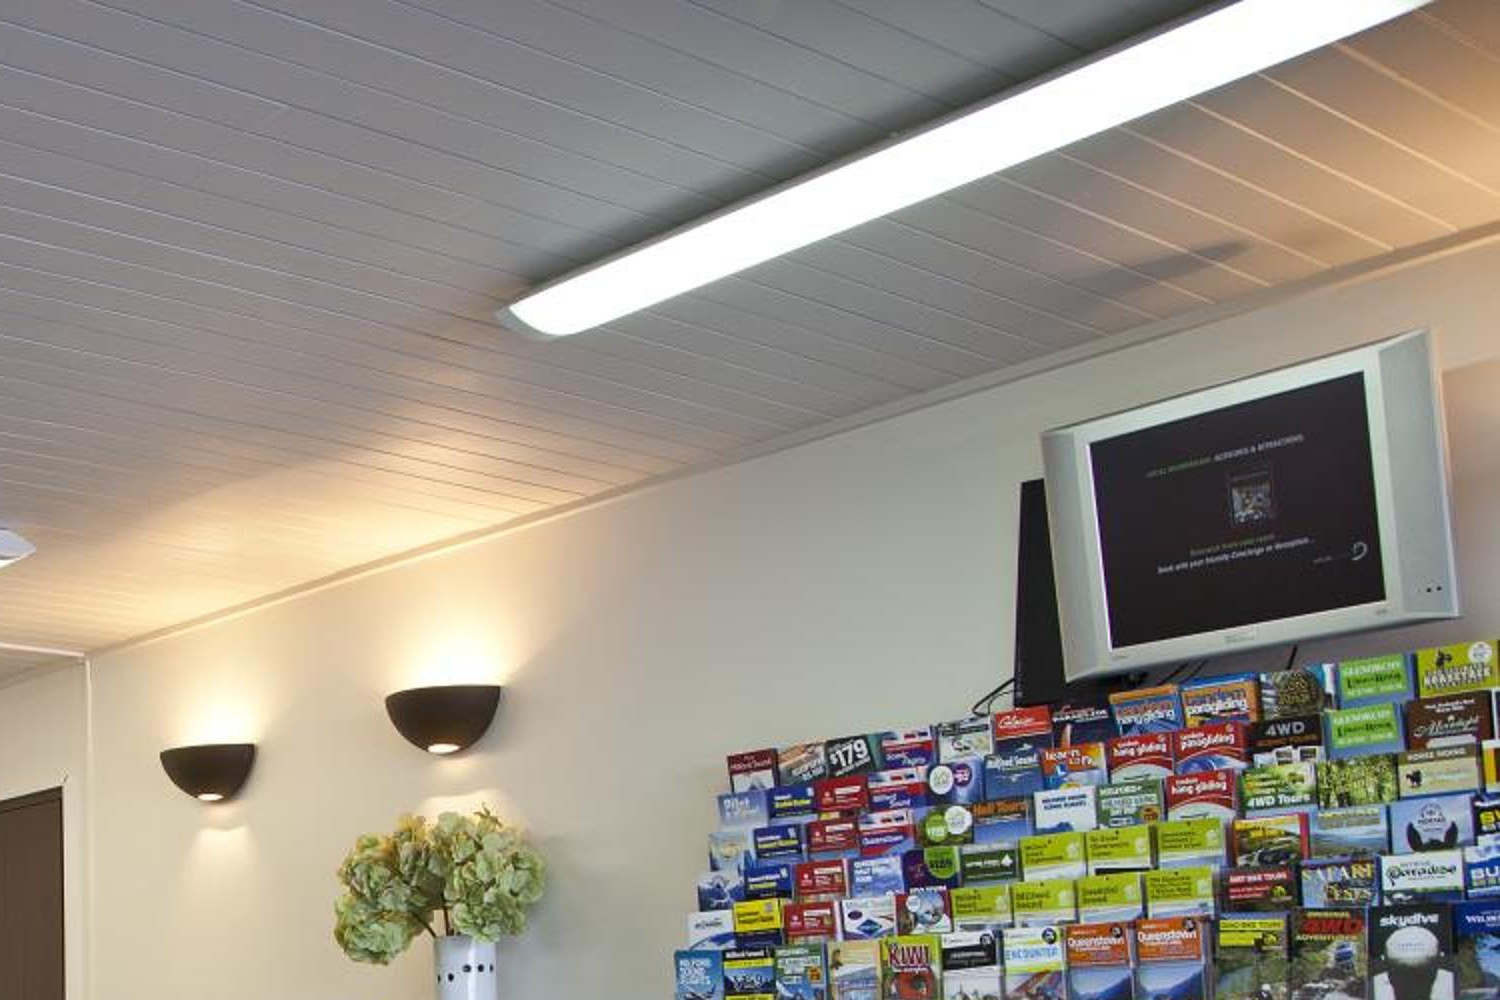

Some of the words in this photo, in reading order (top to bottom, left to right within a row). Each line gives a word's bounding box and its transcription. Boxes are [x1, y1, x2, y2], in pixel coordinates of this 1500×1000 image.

[1265, 721, 1305, 736] 4WD
[829, 738, 868, 768] $179
[1247, 797, 1275, 807] 4WD
[1277, 793, 1311, 805] Tours
[1379, 912, 1439, 928] skydive
[1068, 935, 1124, 947] Queenstown
[1137, 928, 1197, 944] Queenstown
